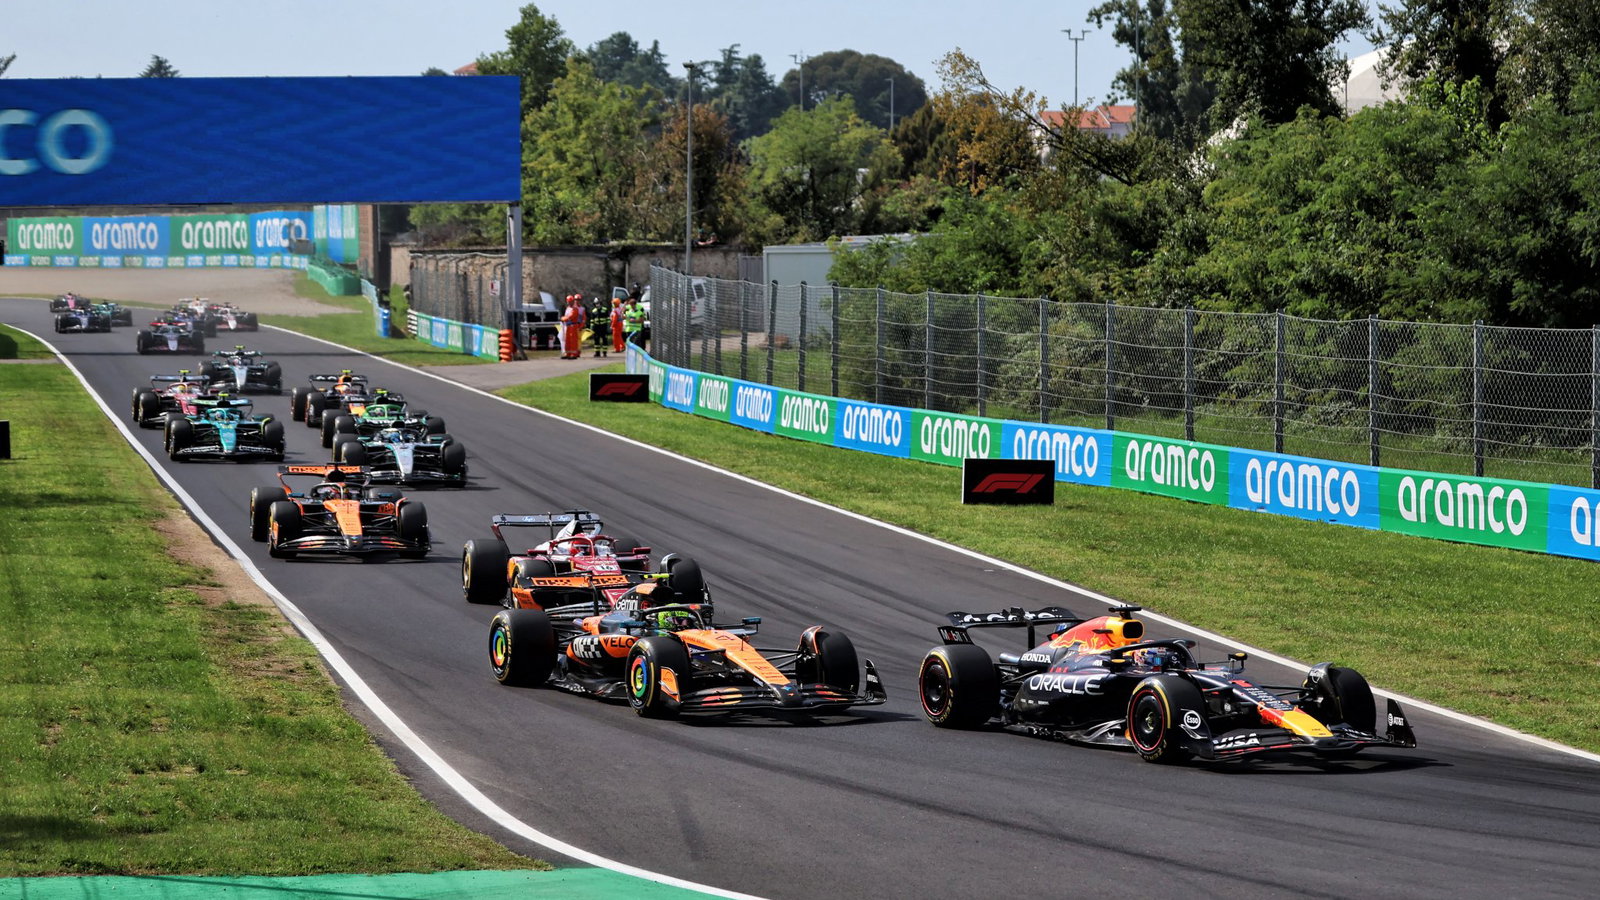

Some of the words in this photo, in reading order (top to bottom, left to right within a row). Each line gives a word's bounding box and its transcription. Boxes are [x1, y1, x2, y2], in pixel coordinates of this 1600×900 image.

[18, 222, 74, 250] aramco
[92, 221, 158, 250] aramco
[181, 220, 248, 249] aramco
[667, 371, 693, 406] aramco
[699, 377, 729, 412] aramco
[736, 385, 772, 423] aramco
[780, 394, 829, 435] aramco
[843, 405, 902, 447] aramco
[920, 415, 991, 459] aramco
[1013, 428, 1099, 478] aramco
[1125, 439, 1216, 492] aramco
[972, 473, 1045, 494] F1
[1245, 457, 1361, 517] aramco
[1397, 475, 1528, 536] aramco
[1570, 496, 1600, 547] a
[615, 595, 639, 610] Gemini
[603, 636, 635, 648] VELO
[1020, 652, 1052, 664] HONDA
[1029, 674, 1104, 695] ORACLE
[1186, 715, 1199, 724] Esso
[1212, 732, 1260, 750] VISA
